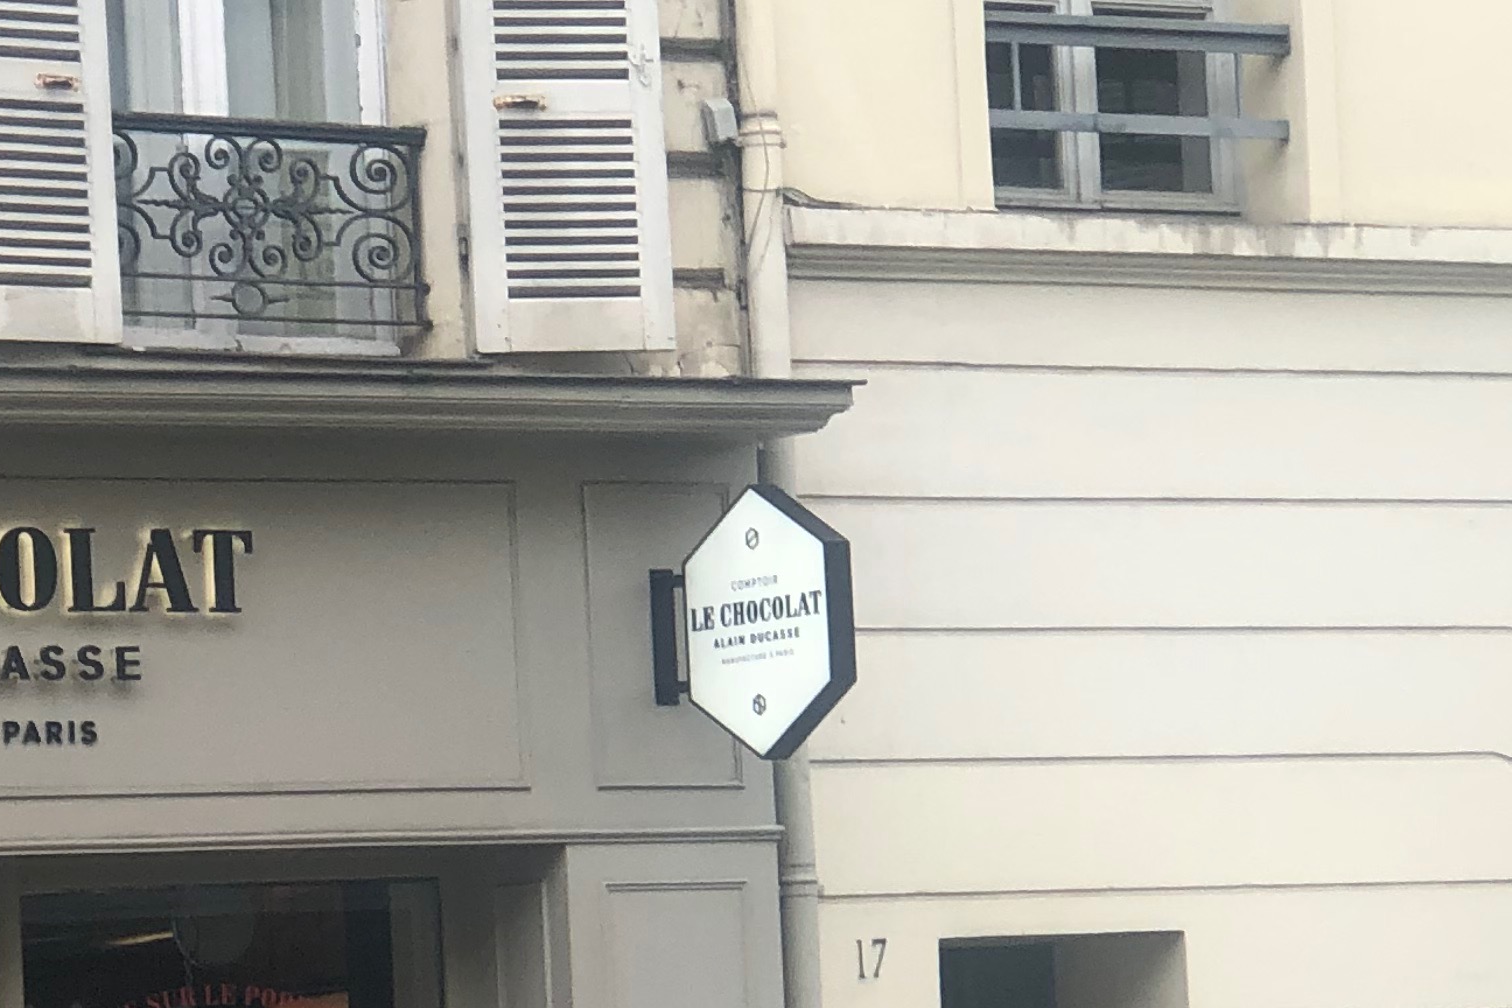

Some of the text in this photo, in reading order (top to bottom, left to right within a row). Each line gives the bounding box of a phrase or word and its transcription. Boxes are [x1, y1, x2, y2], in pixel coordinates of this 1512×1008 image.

[690, 589, 822, 632] LE CHOCOLAT
[713, 627, 800, 649] ALAIN DUCASSE
[2, 720, 98, 746] PARIS
[856, 938, 887, 979] 17
[204, 983, 235, 1006] LE
